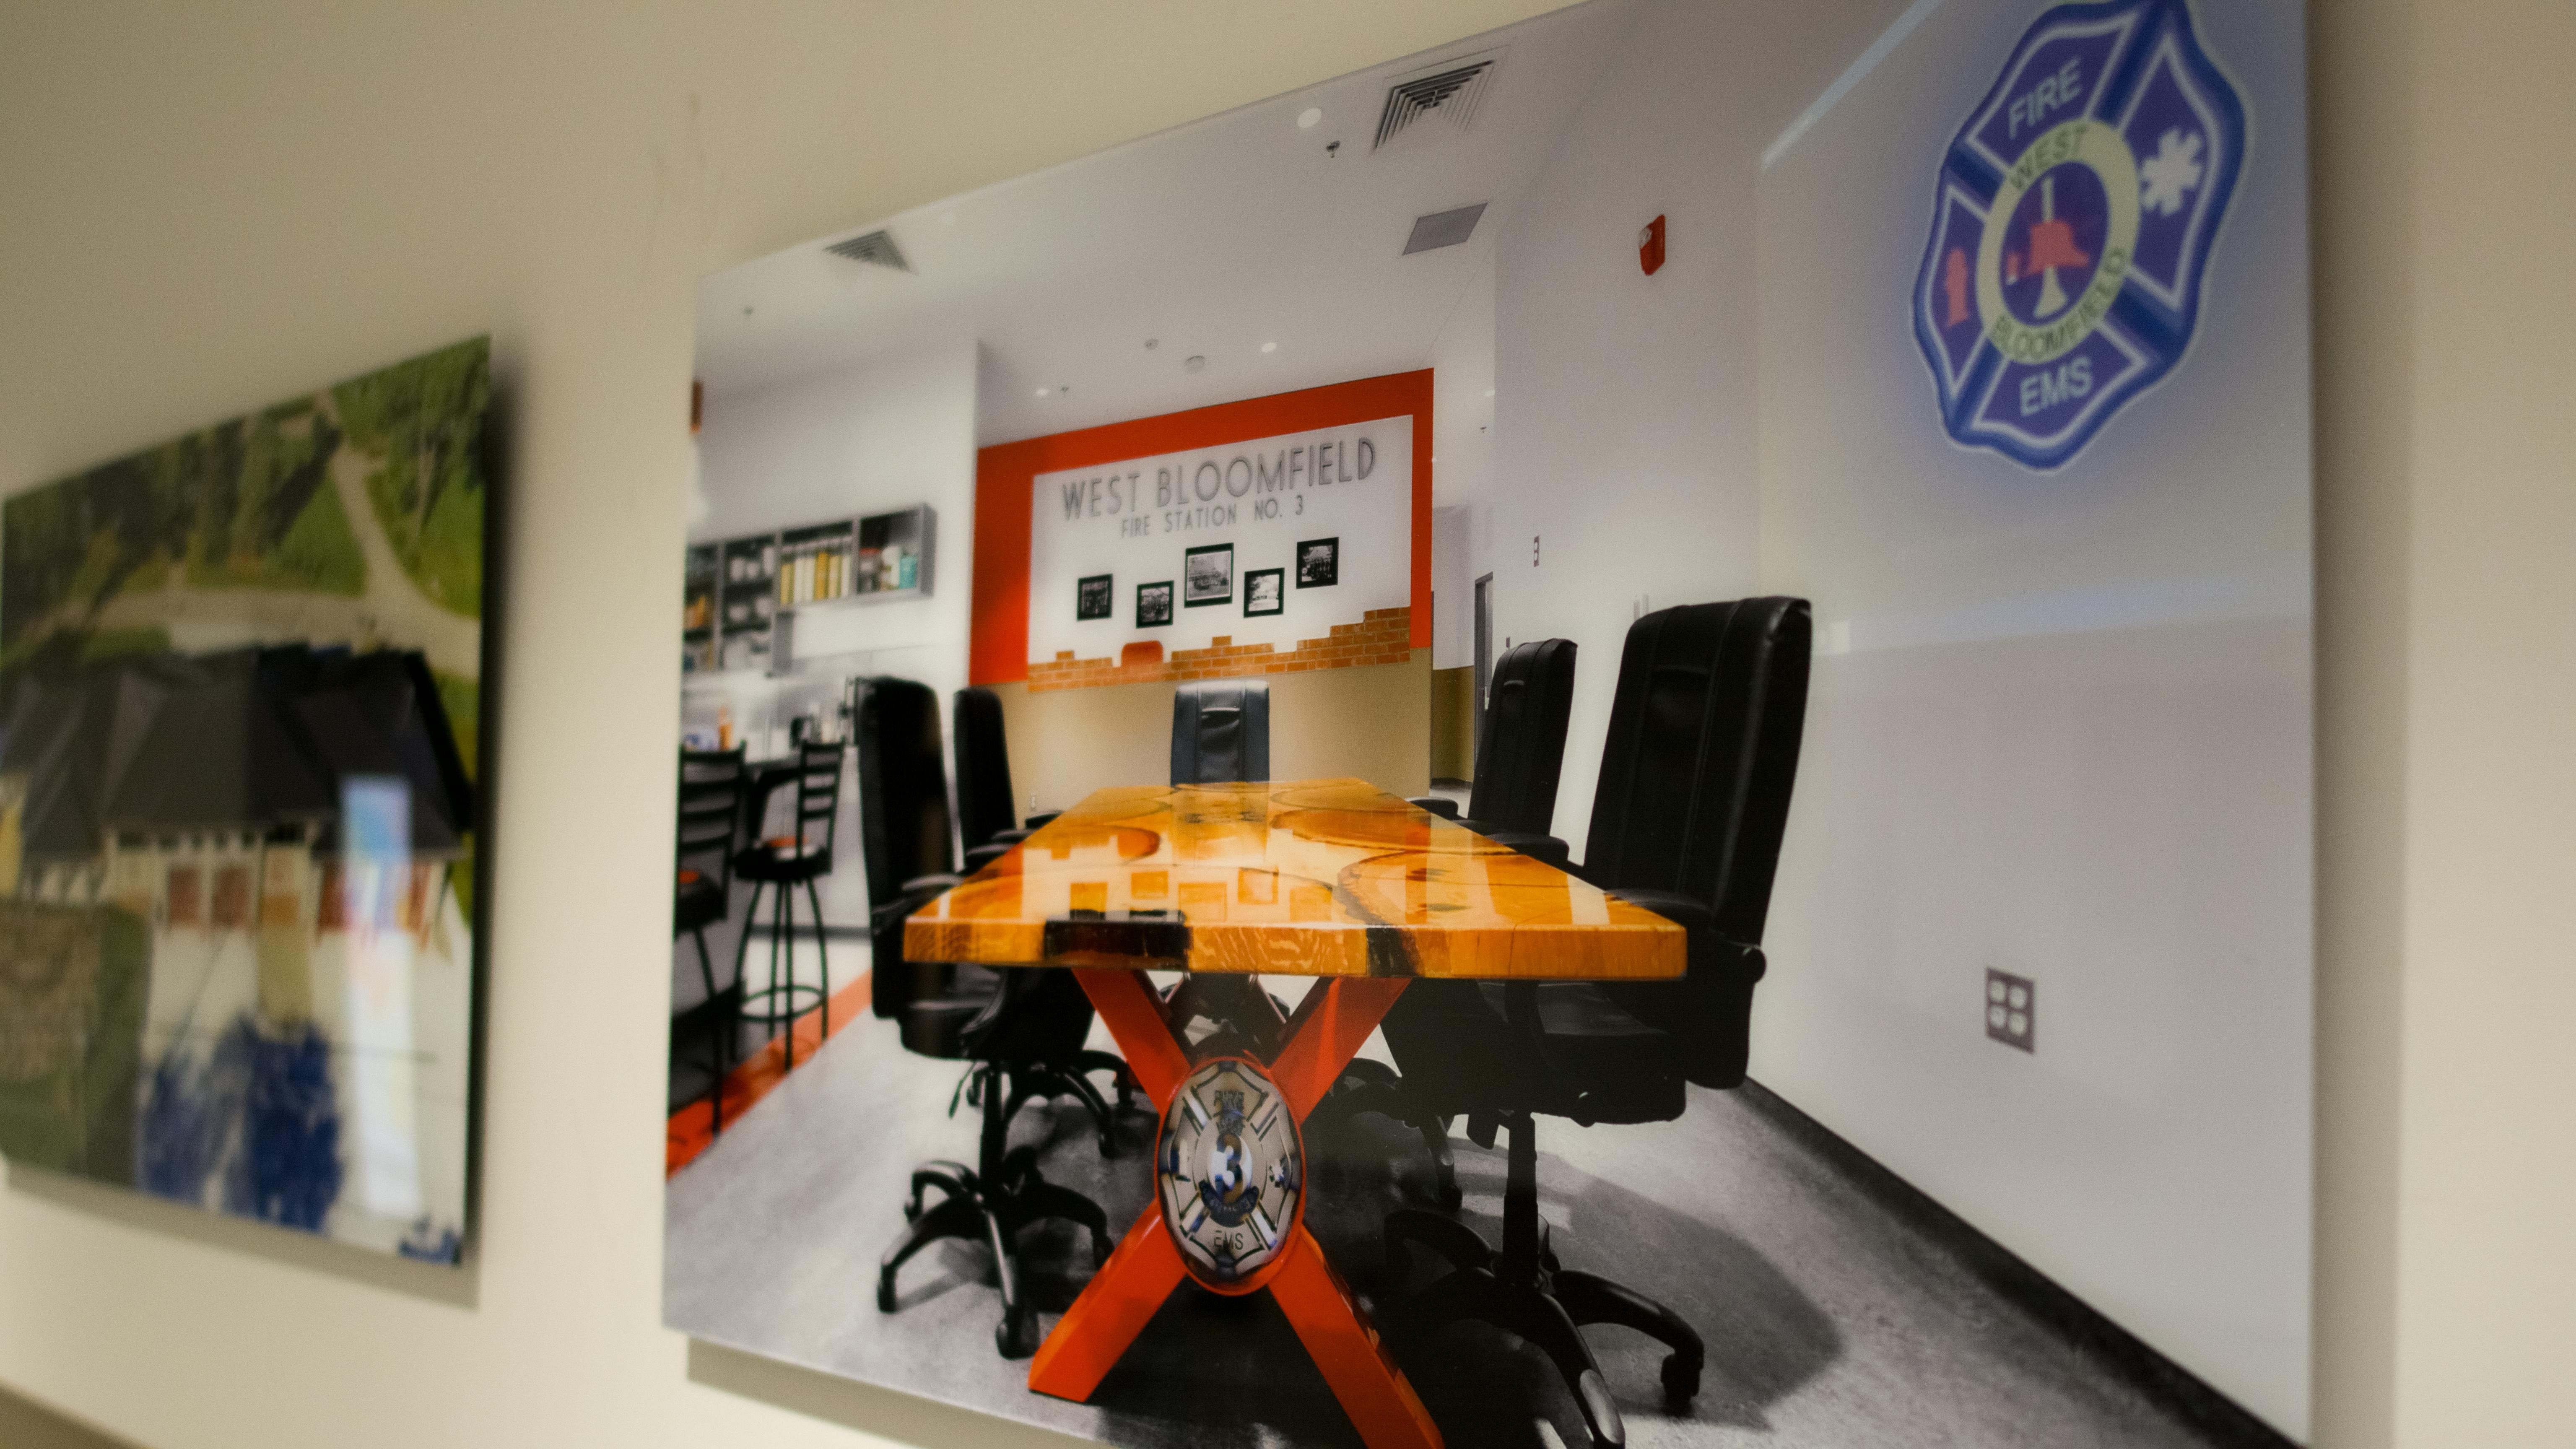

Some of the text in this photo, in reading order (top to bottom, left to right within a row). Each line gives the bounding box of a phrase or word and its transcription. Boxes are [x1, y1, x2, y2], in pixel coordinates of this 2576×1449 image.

[2009, 58, 2082, 140] FIRE
[2011, 125, 2087, 190] WEST
[2019, 356, 2093, 417] EMS
[1062, 437, 1376, 521] WEST BLOOMFIELD
[1120, 494, 1304, 538] FIRE STATION NO. 3
[1215, 1133, 1243, 1203] 3
[1214, 1230, 1244, 1250] EMS
